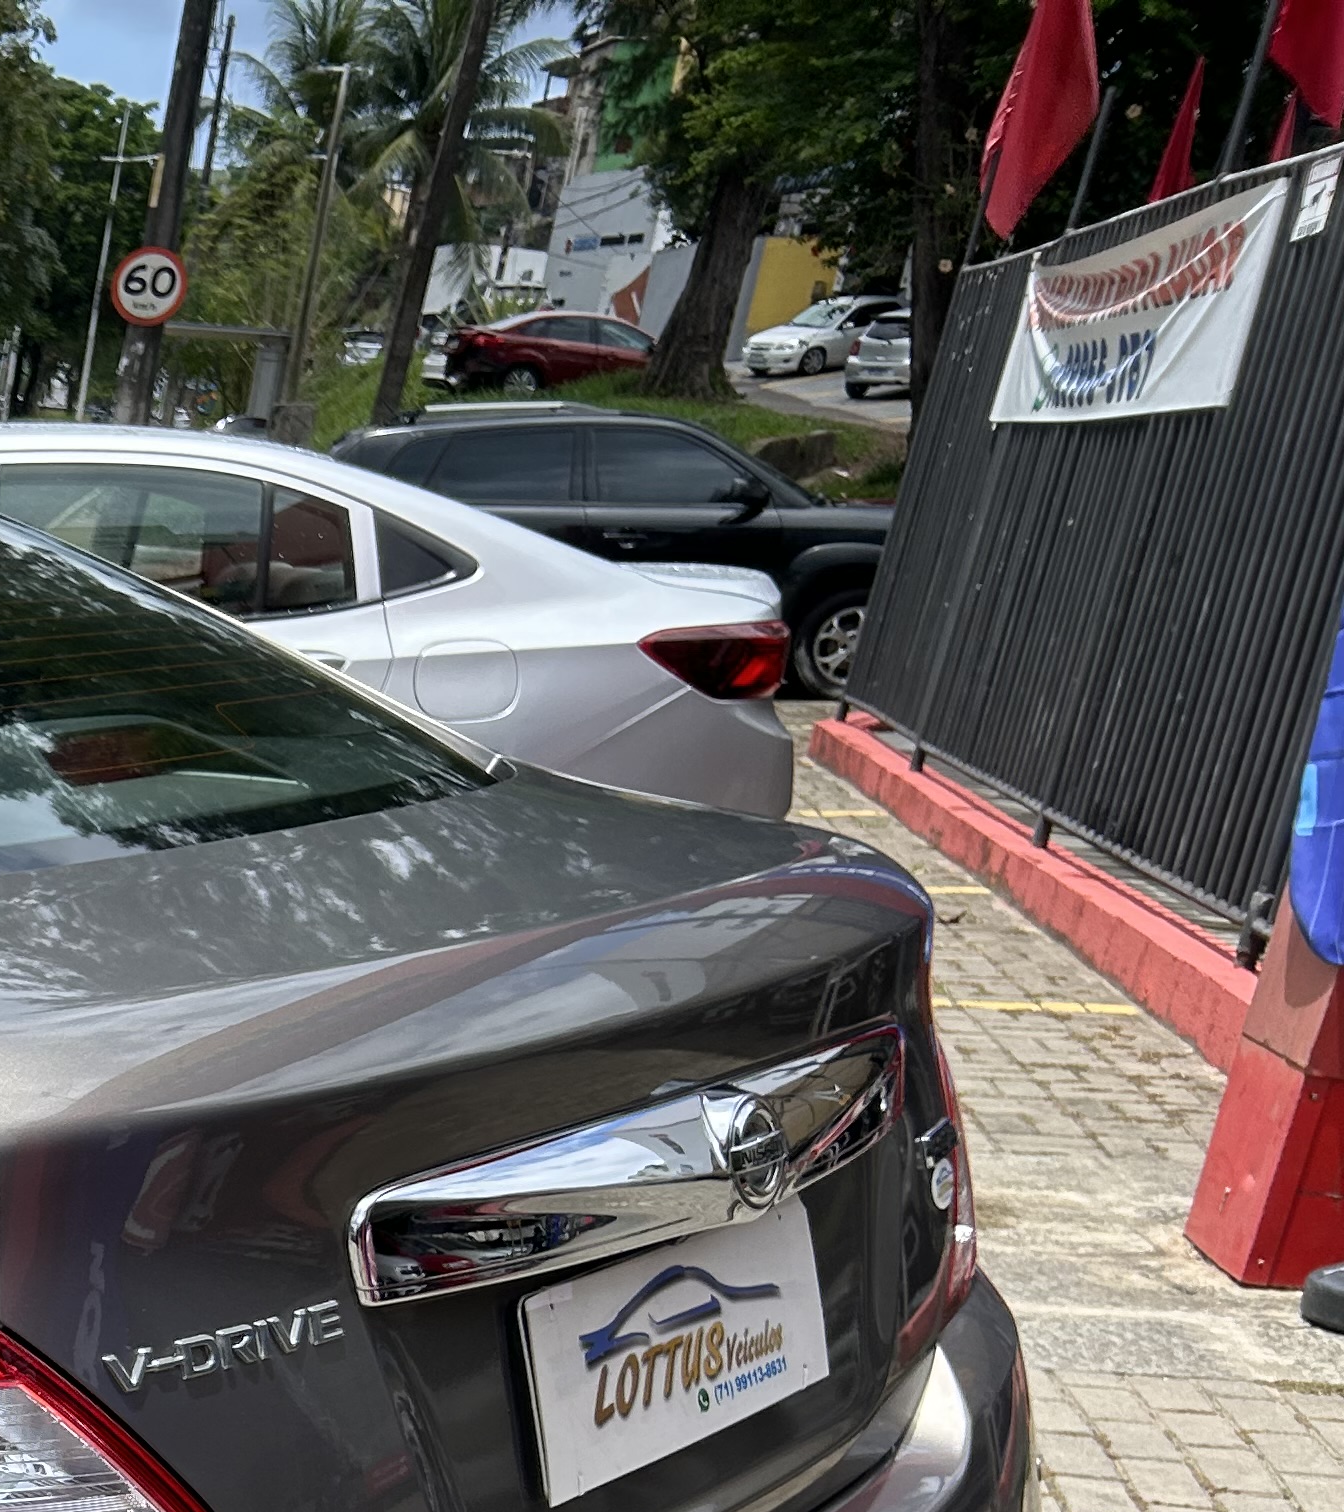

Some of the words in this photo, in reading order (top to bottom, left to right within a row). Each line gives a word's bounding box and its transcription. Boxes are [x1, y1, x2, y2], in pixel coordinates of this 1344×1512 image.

[123, 264, 176, 297] 60
[101, 1299, 346, 1393] V-DRIVE
[594, 1321, 725, 1427] LOTTUS
[714, 1380, 734, 1405] (71)
